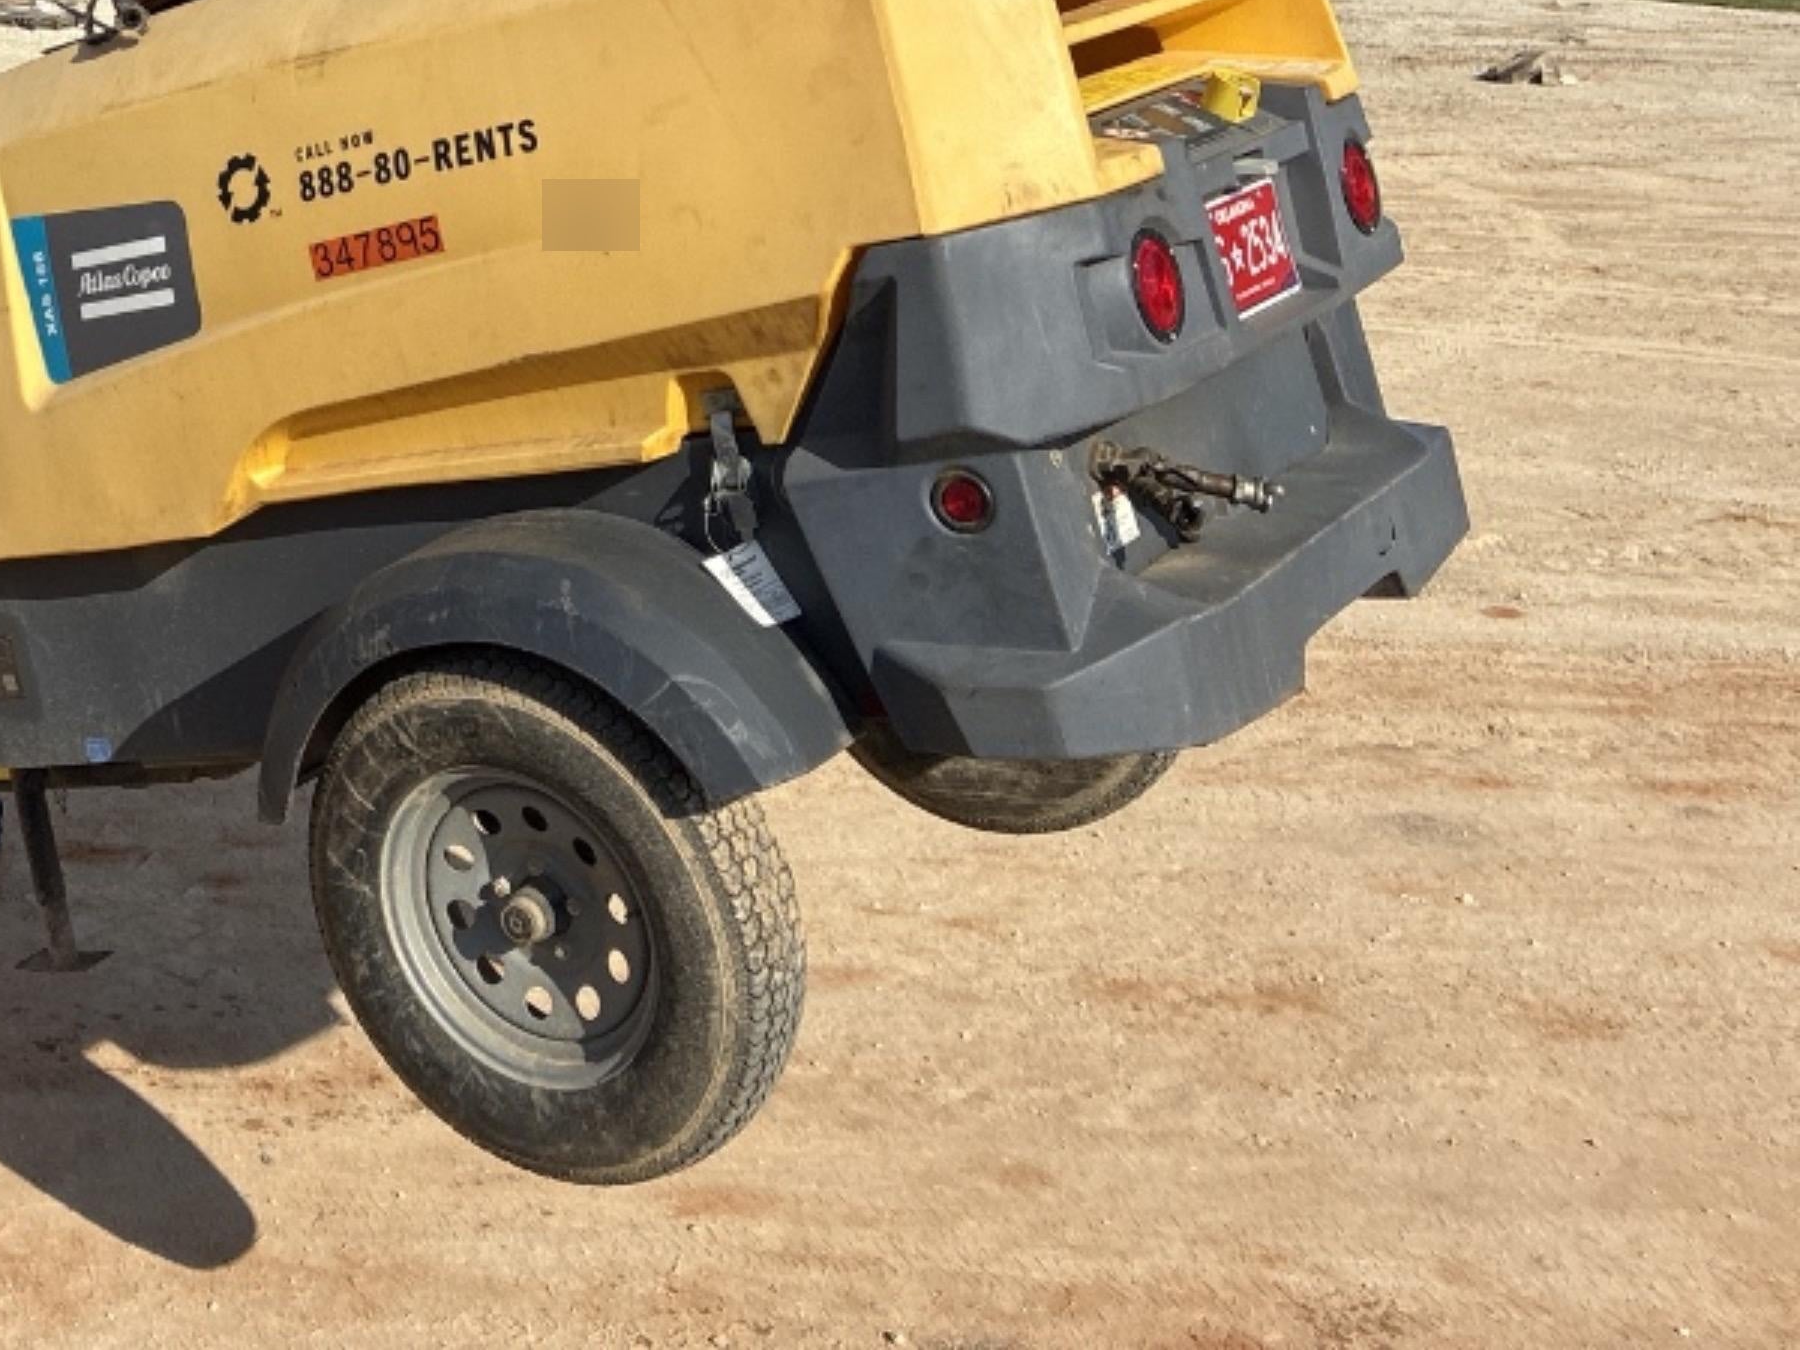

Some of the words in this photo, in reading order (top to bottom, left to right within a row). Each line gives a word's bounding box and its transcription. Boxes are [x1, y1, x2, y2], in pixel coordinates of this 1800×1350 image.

[295, 140, 333, 162] CALL
[340, 129, 373, 151] NOW
[299, 118, 538, 202] 888-80-RENTS
[313, 215, 440, 278] 347895
